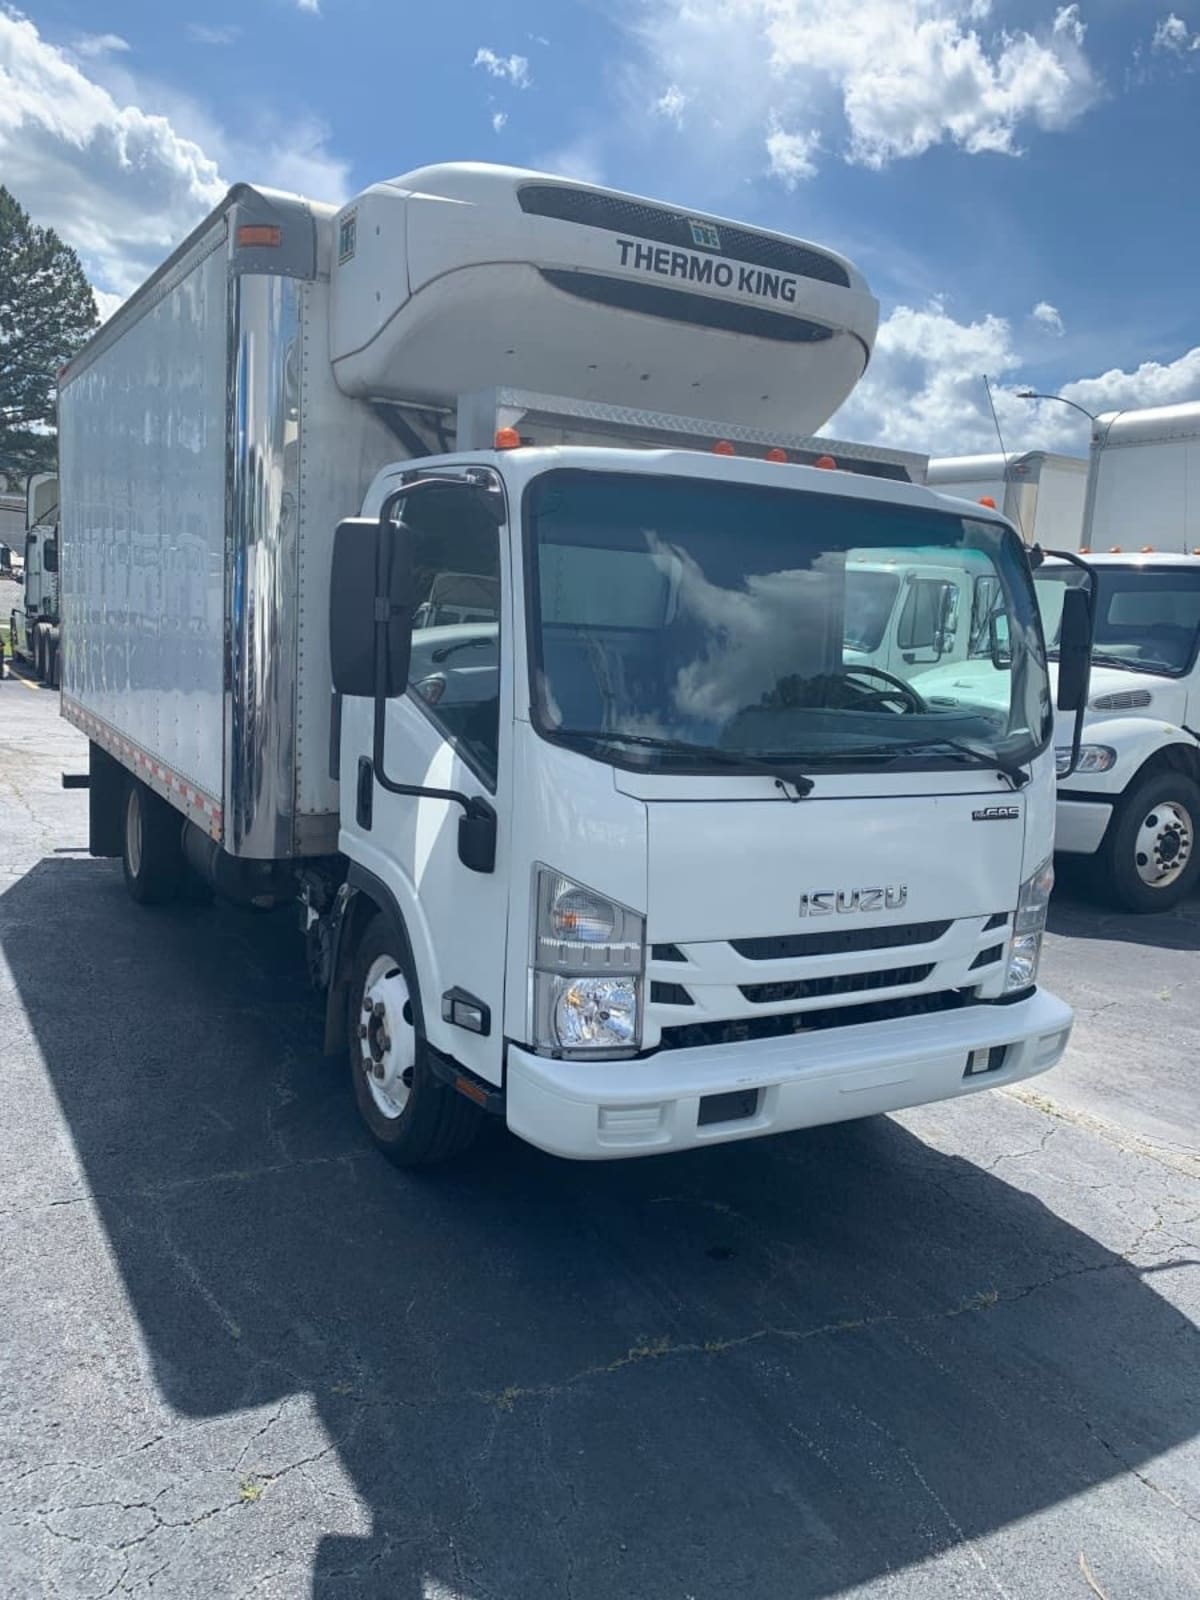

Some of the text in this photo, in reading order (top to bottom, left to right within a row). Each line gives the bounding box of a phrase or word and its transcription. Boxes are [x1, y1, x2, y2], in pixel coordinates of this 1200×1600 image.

[616, 239, 797, 303] THERMO KING
[799, 884, 907, 917] ISUZU
